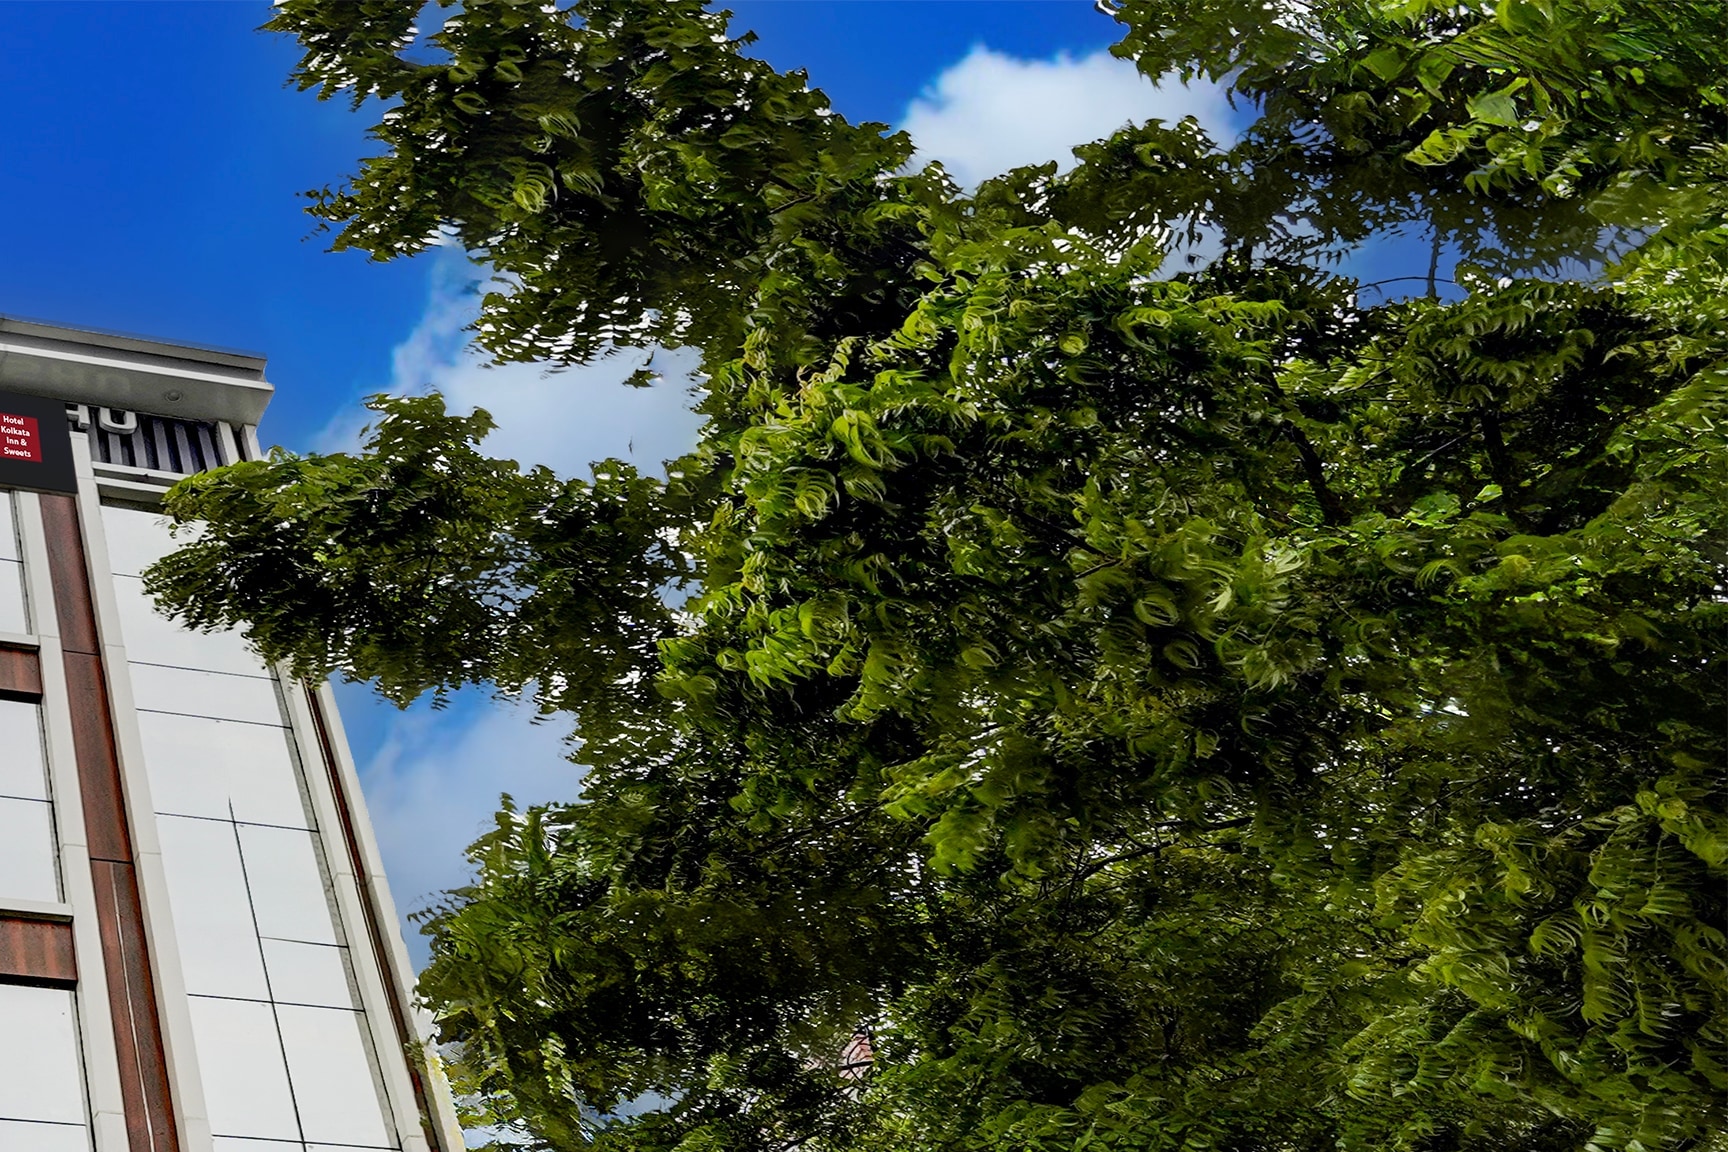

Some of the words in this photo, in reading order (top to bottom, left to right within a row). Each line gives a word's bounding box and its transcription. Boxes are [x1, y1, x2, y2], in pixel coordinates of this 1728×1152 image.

[3, 415, 24, 426] Hotel
[1, 426, 31, 437] Kolkata
[6, 436, 19, 446] Inn
[20, 439, 28, 448] &
[4, 447, 31, 458] Sweets
